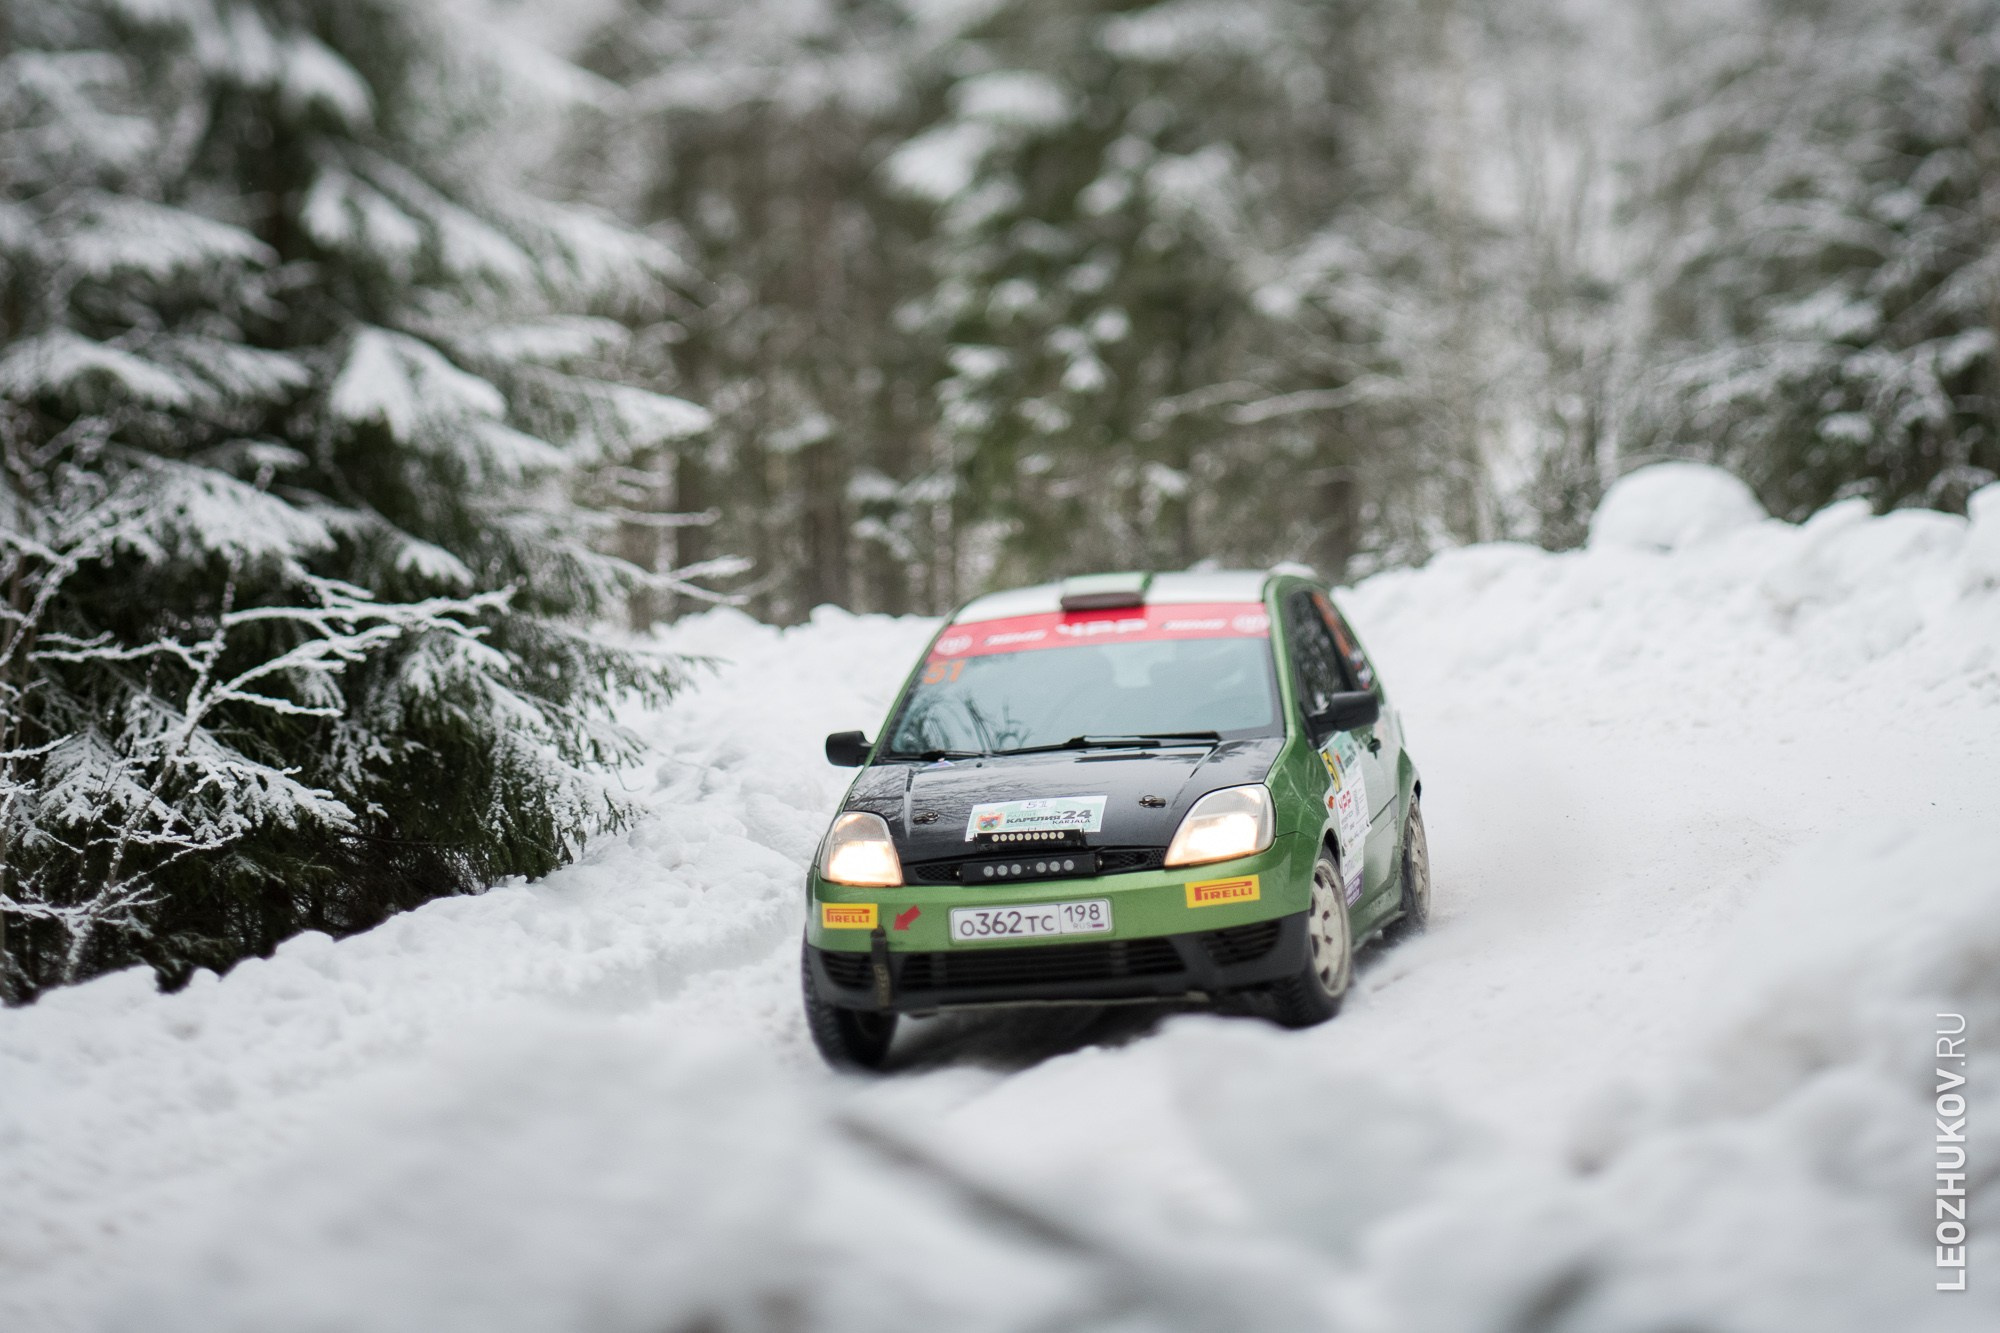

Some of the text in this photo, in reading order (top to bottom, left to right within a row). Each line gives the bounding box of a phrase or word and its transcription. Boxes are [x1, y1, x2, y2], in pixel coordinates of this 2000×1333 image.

[923, 660, 966, 685] 51
[1026, 800, 1048, 809] 51
[1006, 814, 1060, 824] КАРЕЛИЯ
[1194, 881, 1253, 902] PIRELLI
[826, 908, 870, 923] PIRELLI
[1064, 904, 1101, 923] 198
[1073, 922, 1091, 930] RUS
